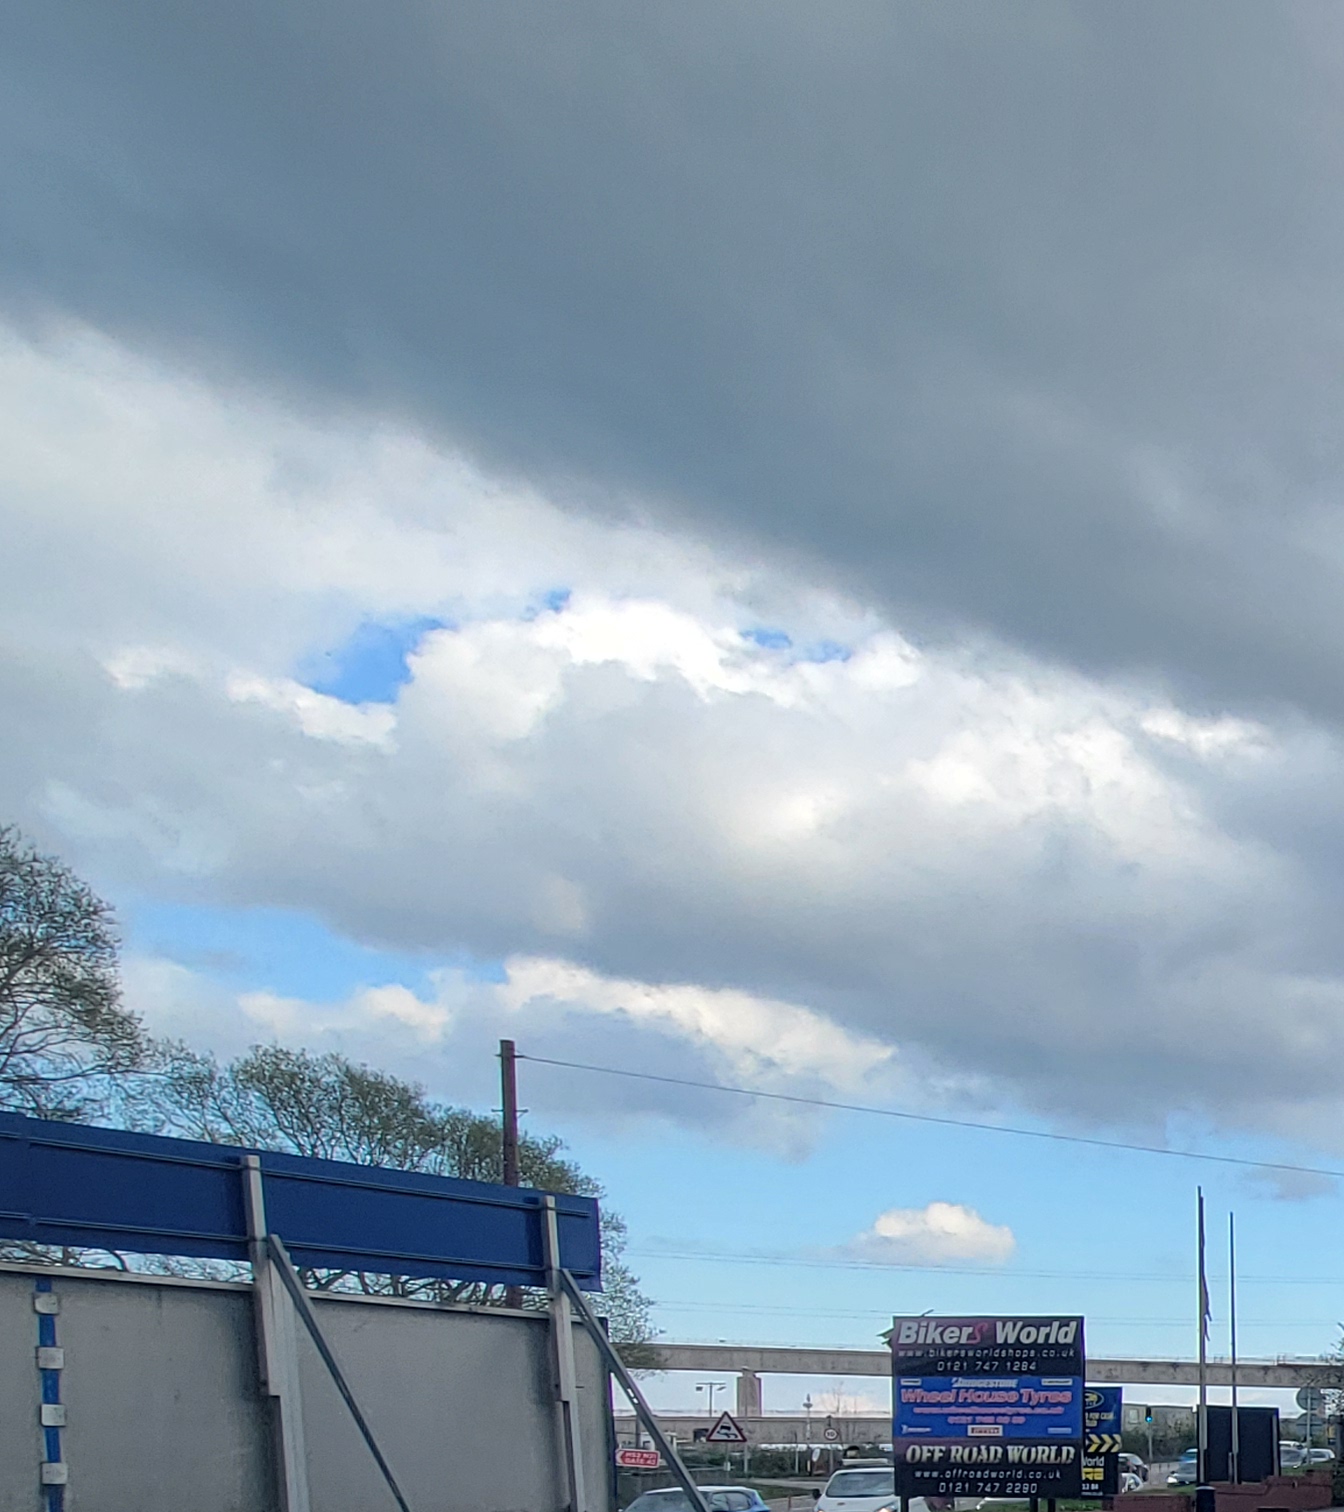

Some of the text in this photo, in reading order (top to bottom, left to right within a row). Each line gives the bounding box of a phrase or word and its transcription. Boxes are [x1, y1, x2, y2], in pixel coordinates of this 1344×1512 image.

[995, 1320, 1077, 1344] World
[898, 1348, 1075, 1358] www.bikersworldshops.co.uk
[936, 1361, 1037, 1371] 0121 747 1284
[901, 1388, 1072, 1406] Wheel House Tyres
[905, 1444, 1075, 1464] OFF ROAD WORLD
[914, 1469, 1061, 1479] www.offroadworld.co.uk
[938, 1482, 969, 1493] 0121
[977, 1482, 1000, 1493] 747
